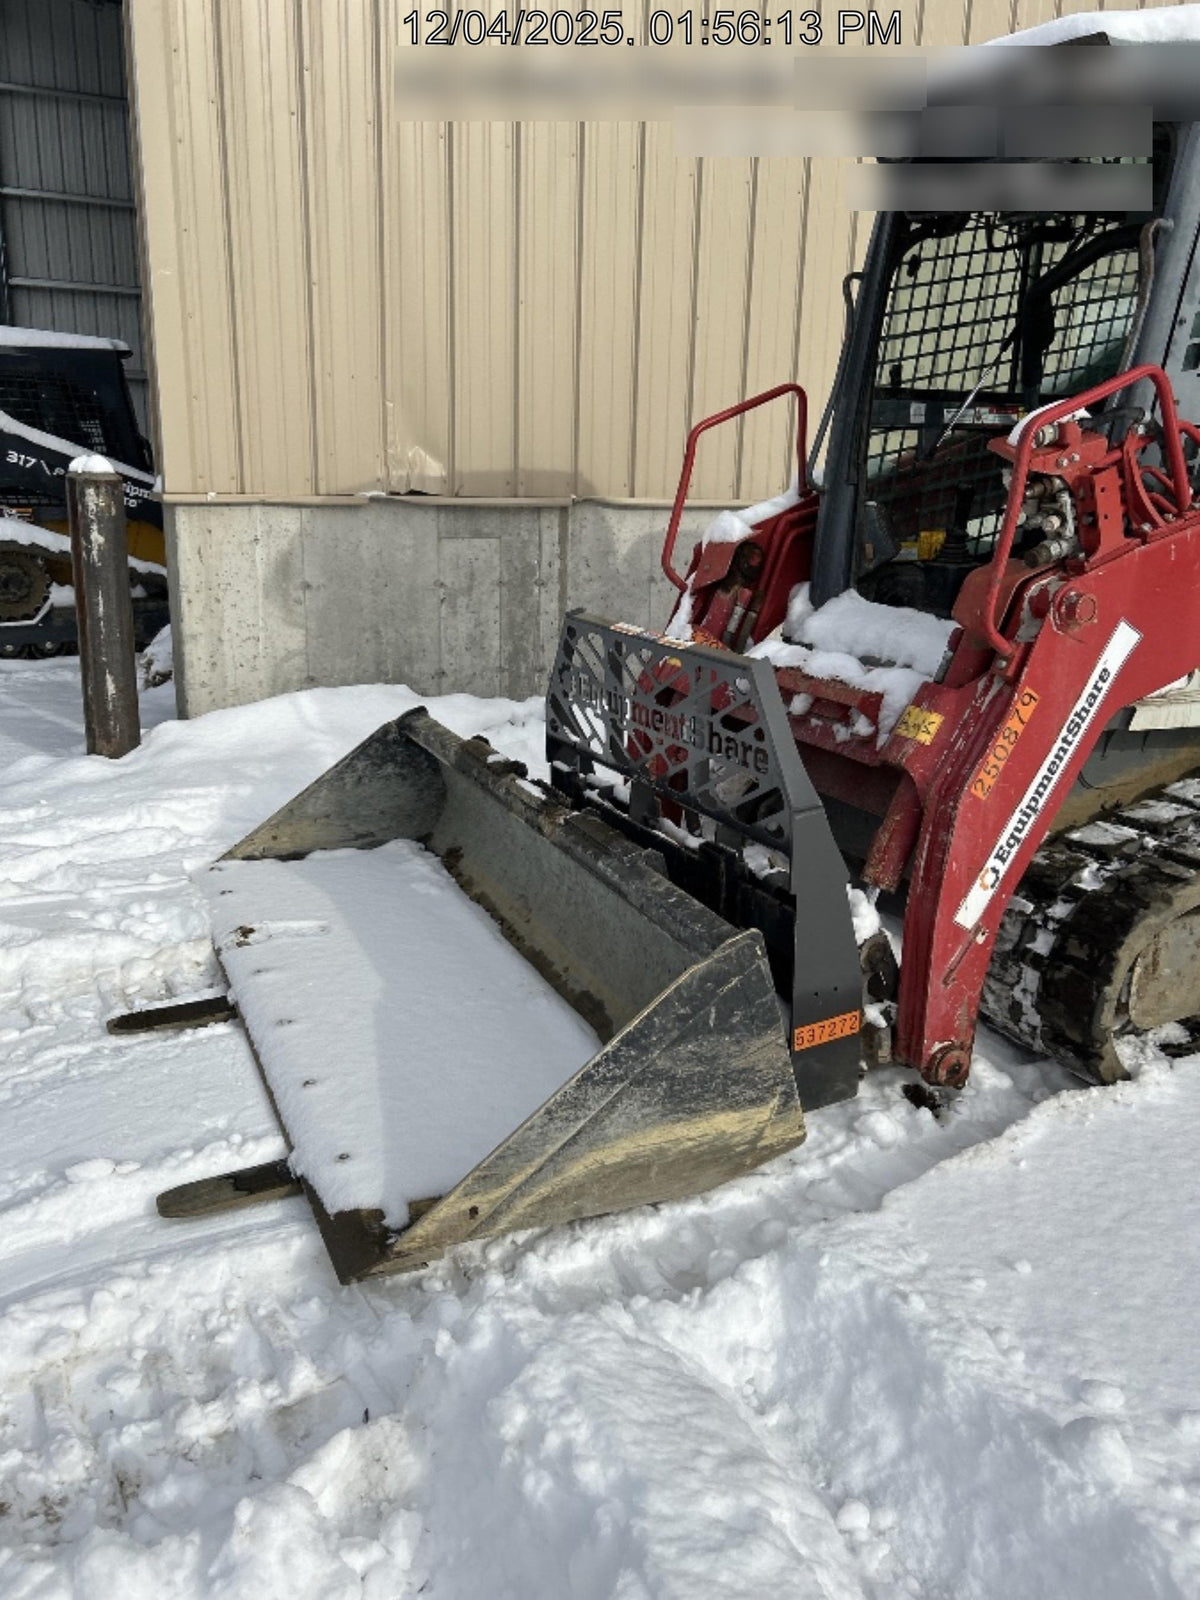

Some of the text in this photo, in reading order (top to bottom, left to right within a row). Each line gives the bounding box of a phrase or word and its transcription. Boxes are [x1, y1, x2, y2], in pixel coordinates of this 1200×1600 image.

[6, 450, 37, 468] 317
[974, 692, 1038, 796] 250879
[994, 666, 1111, 866] EquipmentShare
[796, 1014, 858, 1046] 537272
